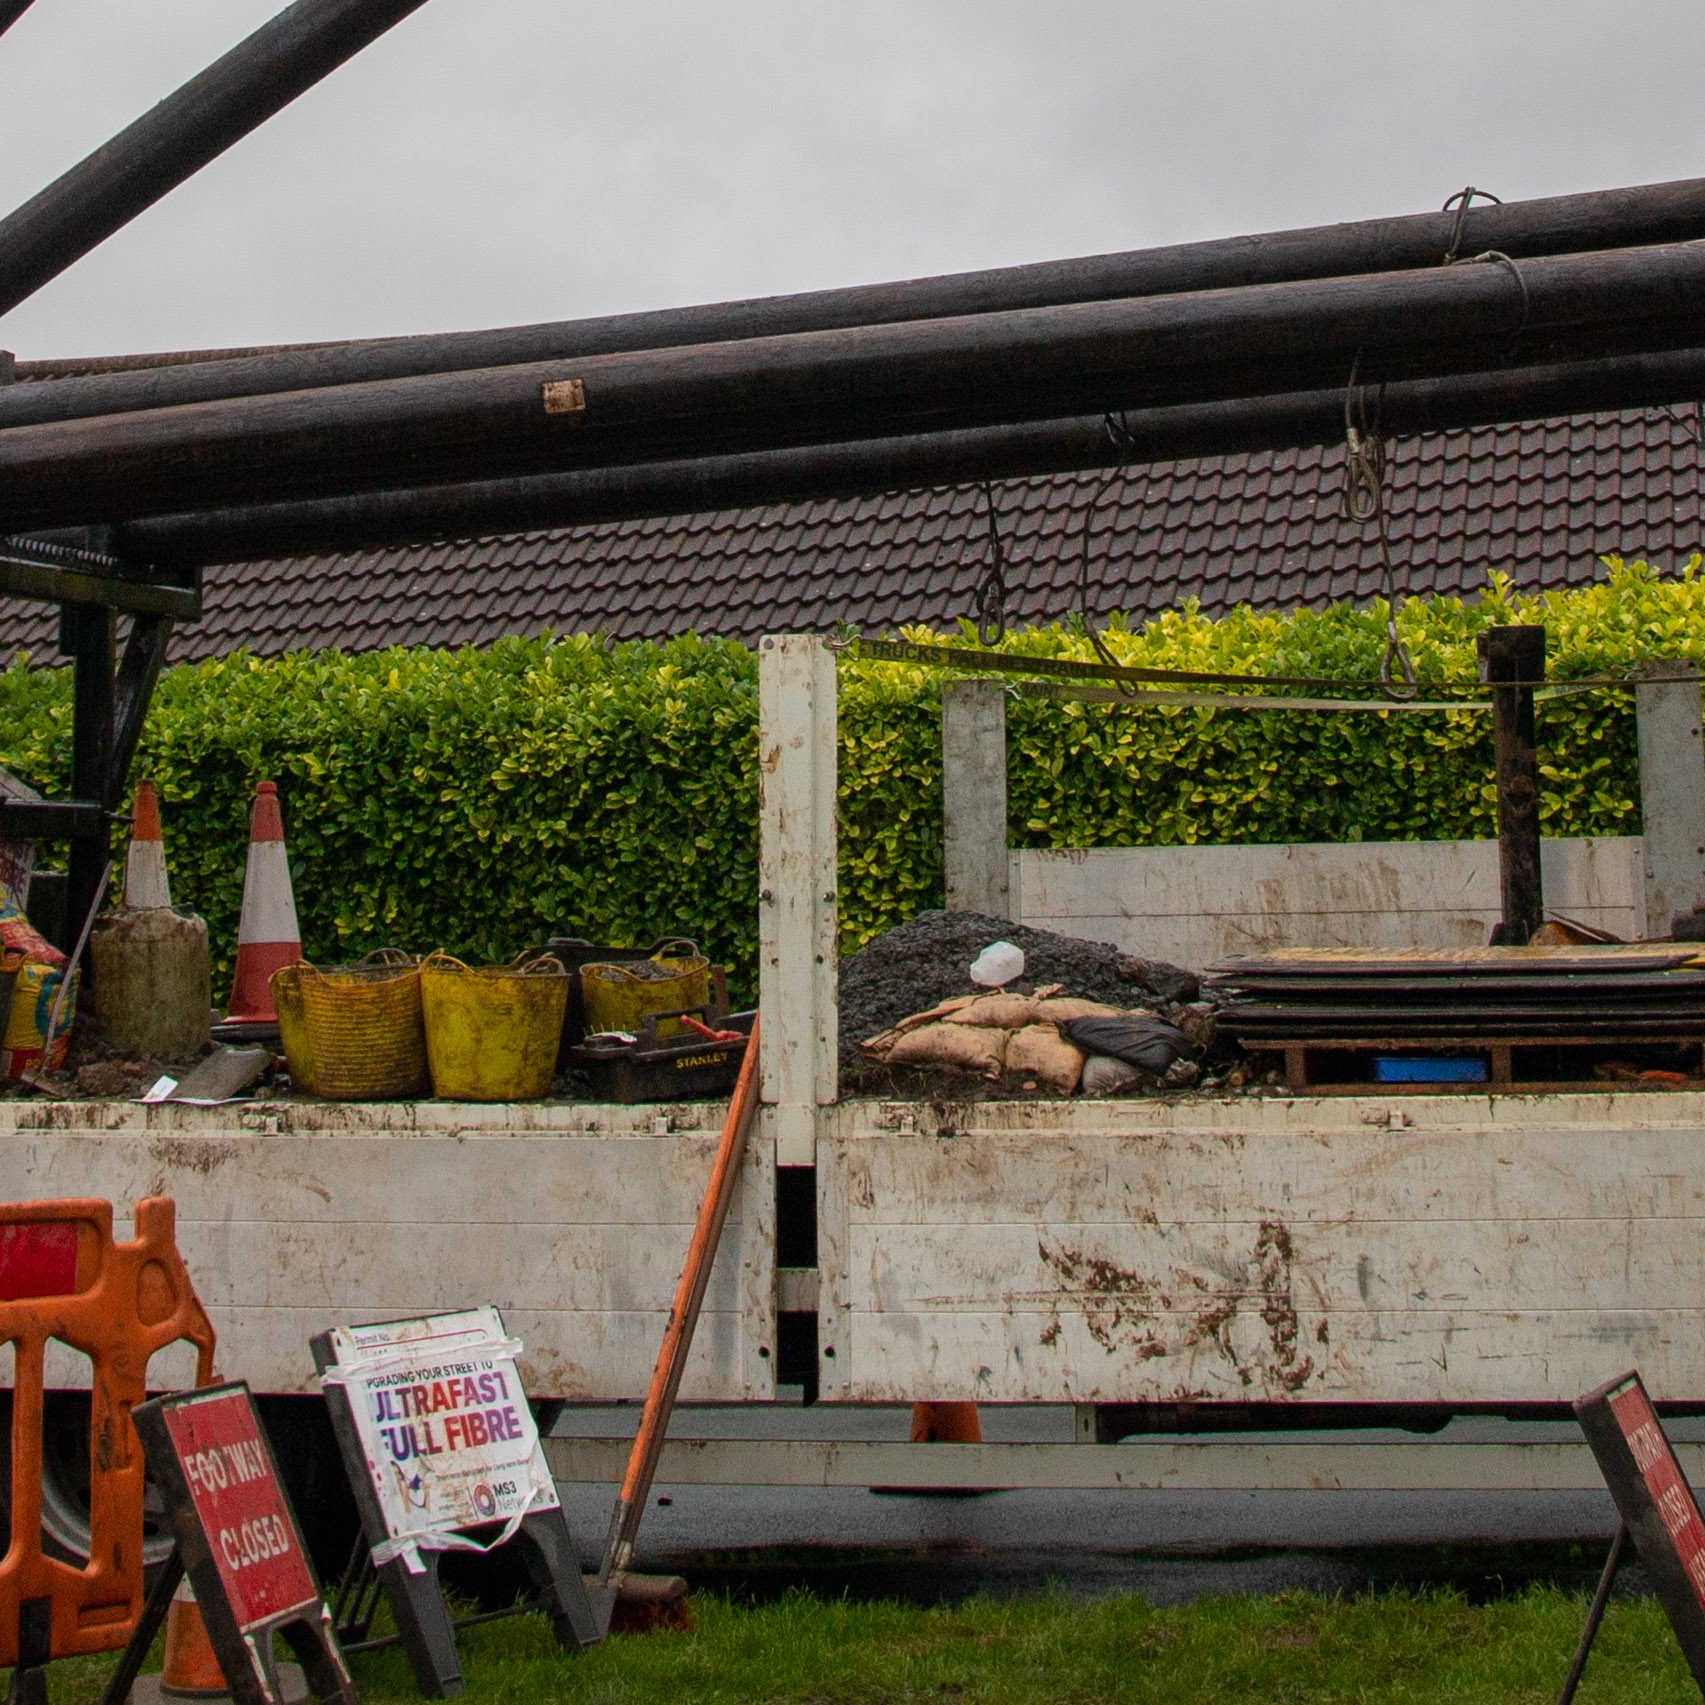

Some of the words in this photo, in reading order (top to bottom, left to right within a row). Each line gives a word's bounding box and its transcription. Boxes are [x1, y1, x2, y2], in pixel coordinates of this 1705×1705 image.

[871, 643, 941, 664] TRUCKS
[676, 1052, 728, 1070] STANLEY
[365, 1371, 415, 1389] PGRADING
[416, 1367, 442, 1381] YOUR
[444, 1361, 479, 1377] STREET
[444, 1405, 524, 1452] FIBRE
[183, 1438, 268, 1496] FOOTWAY
[493, 1480, 517, 1497] MS3
[498, 1493, 544, 1513] Netwks
[219, 1512, 290, 1572] CLOSED
